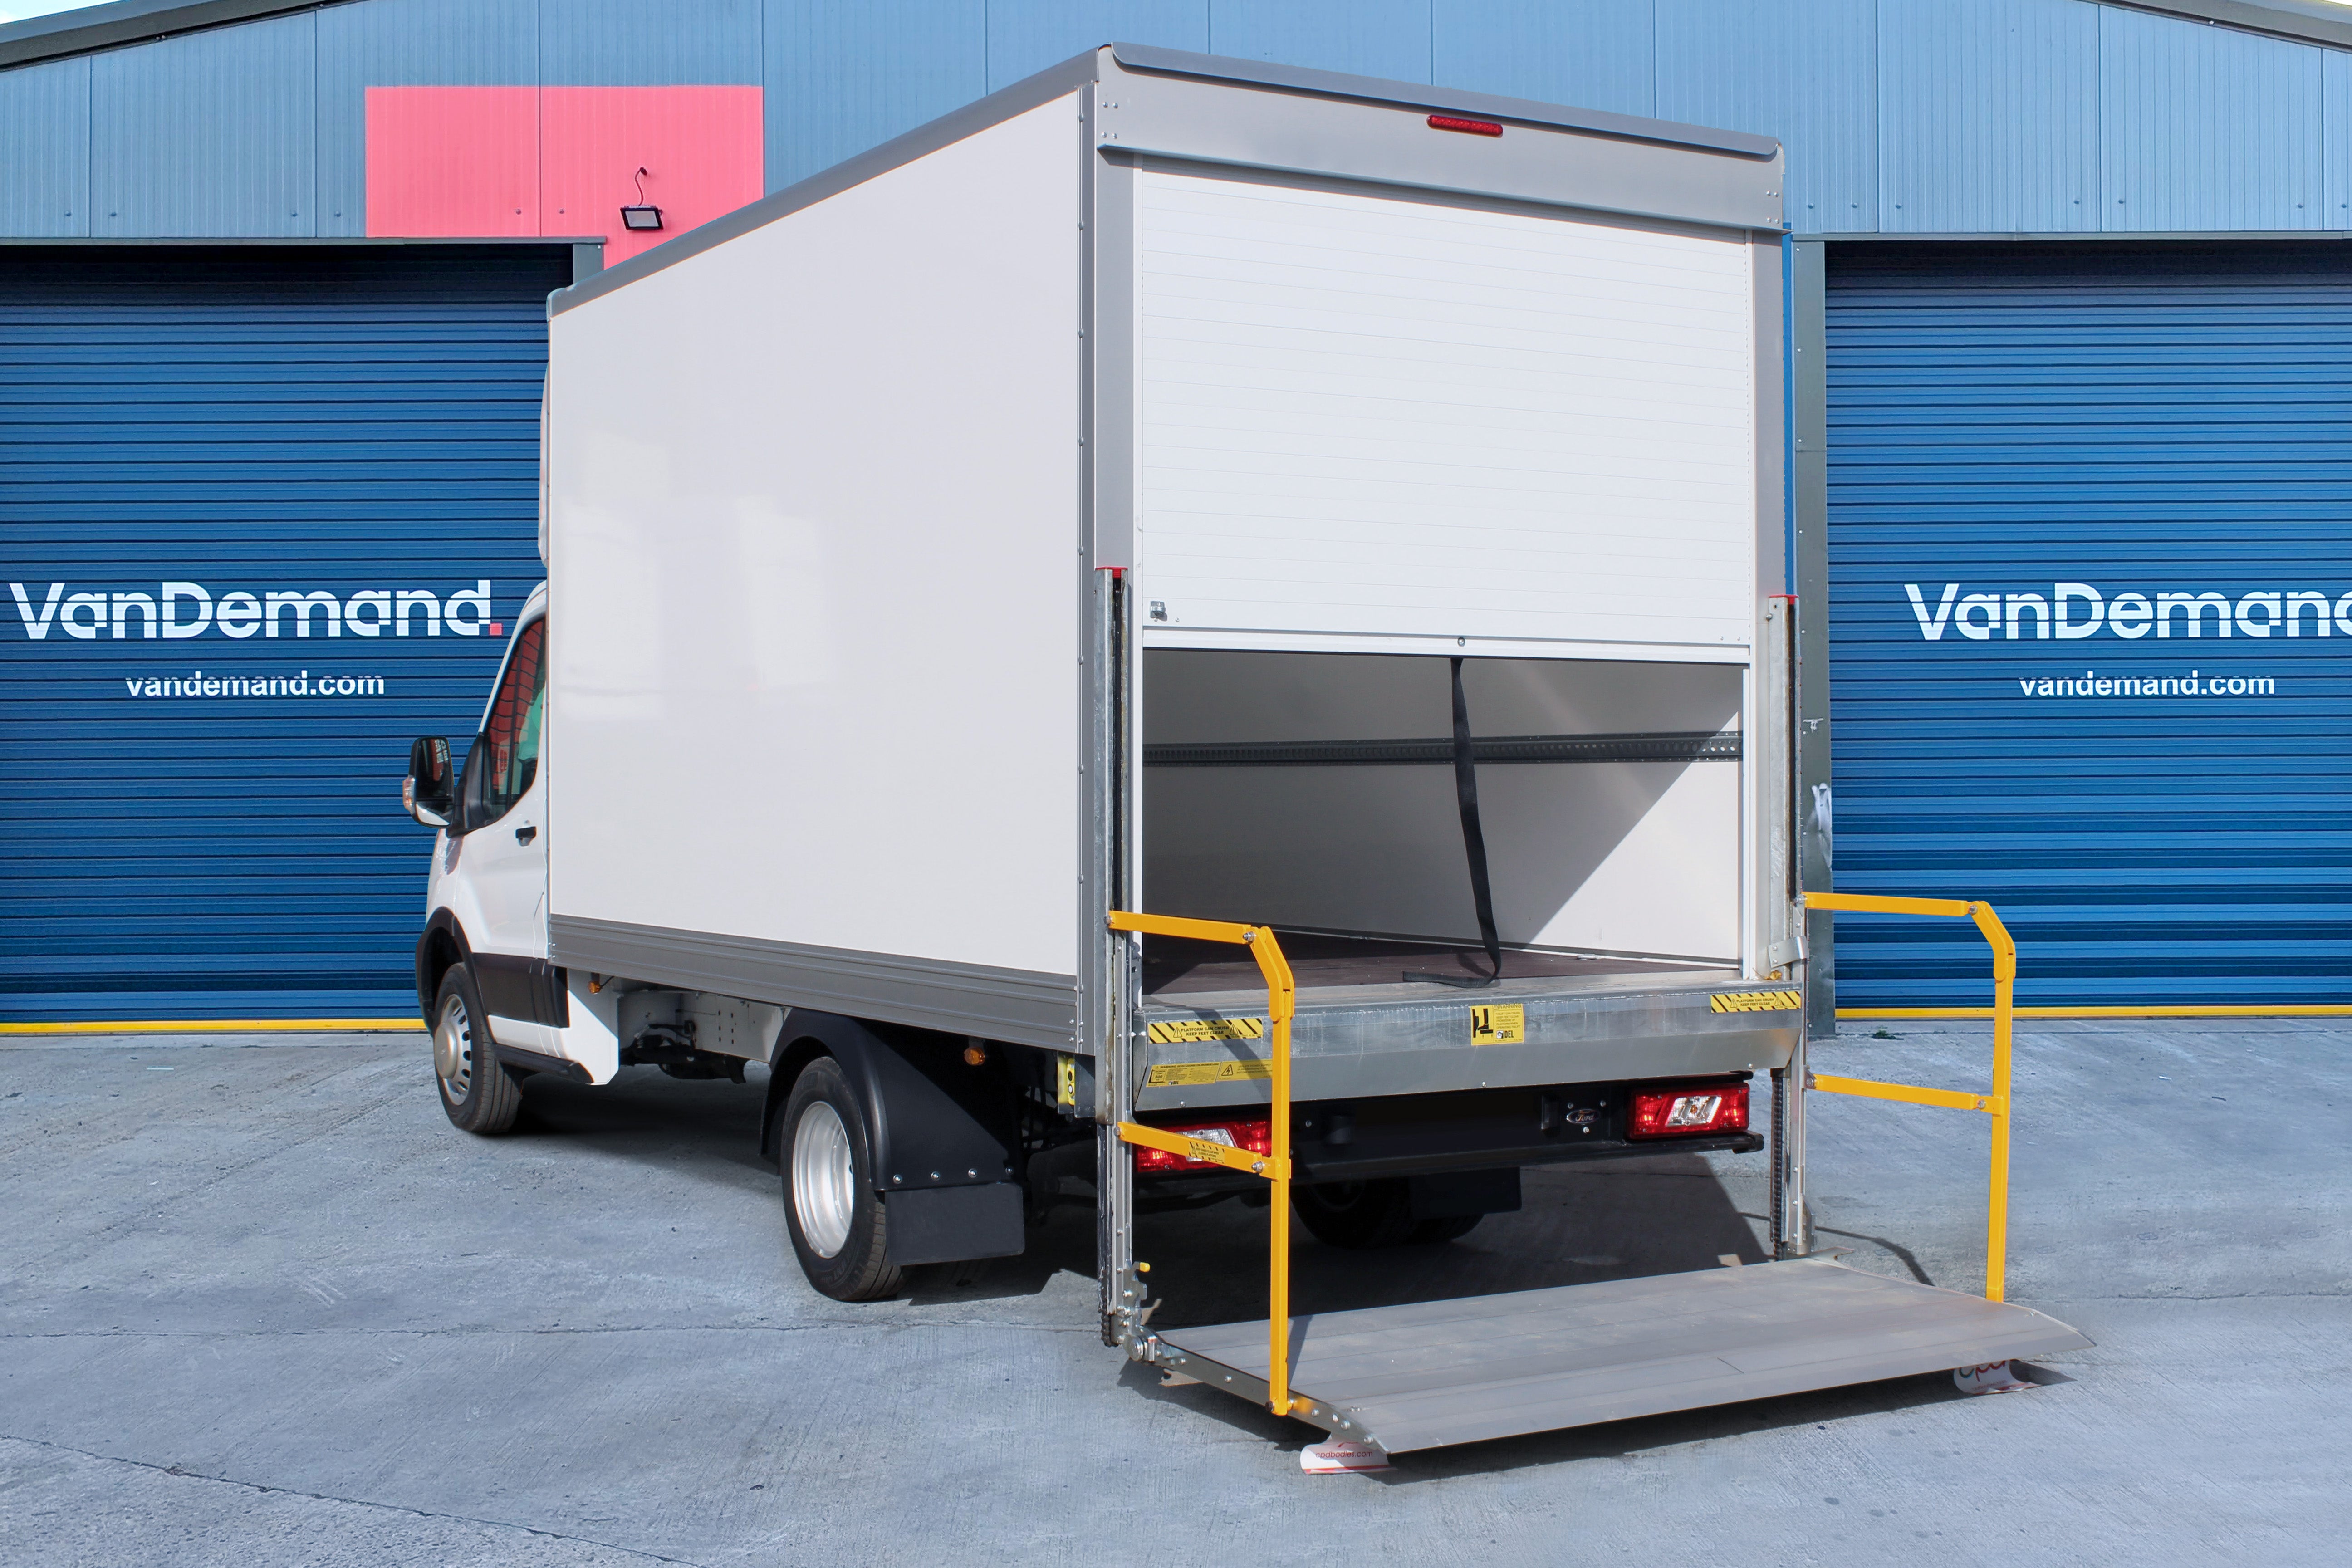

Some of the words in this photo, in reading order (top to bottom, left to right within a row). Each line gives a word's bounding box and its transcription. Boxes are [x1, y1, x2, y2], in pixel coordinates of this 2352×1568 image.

[126, 671, 385, 696] vandemand.com
[2019, 670, 2275, 696] vandemand.com
[1575, 1110, 1595, 1122] Ford
